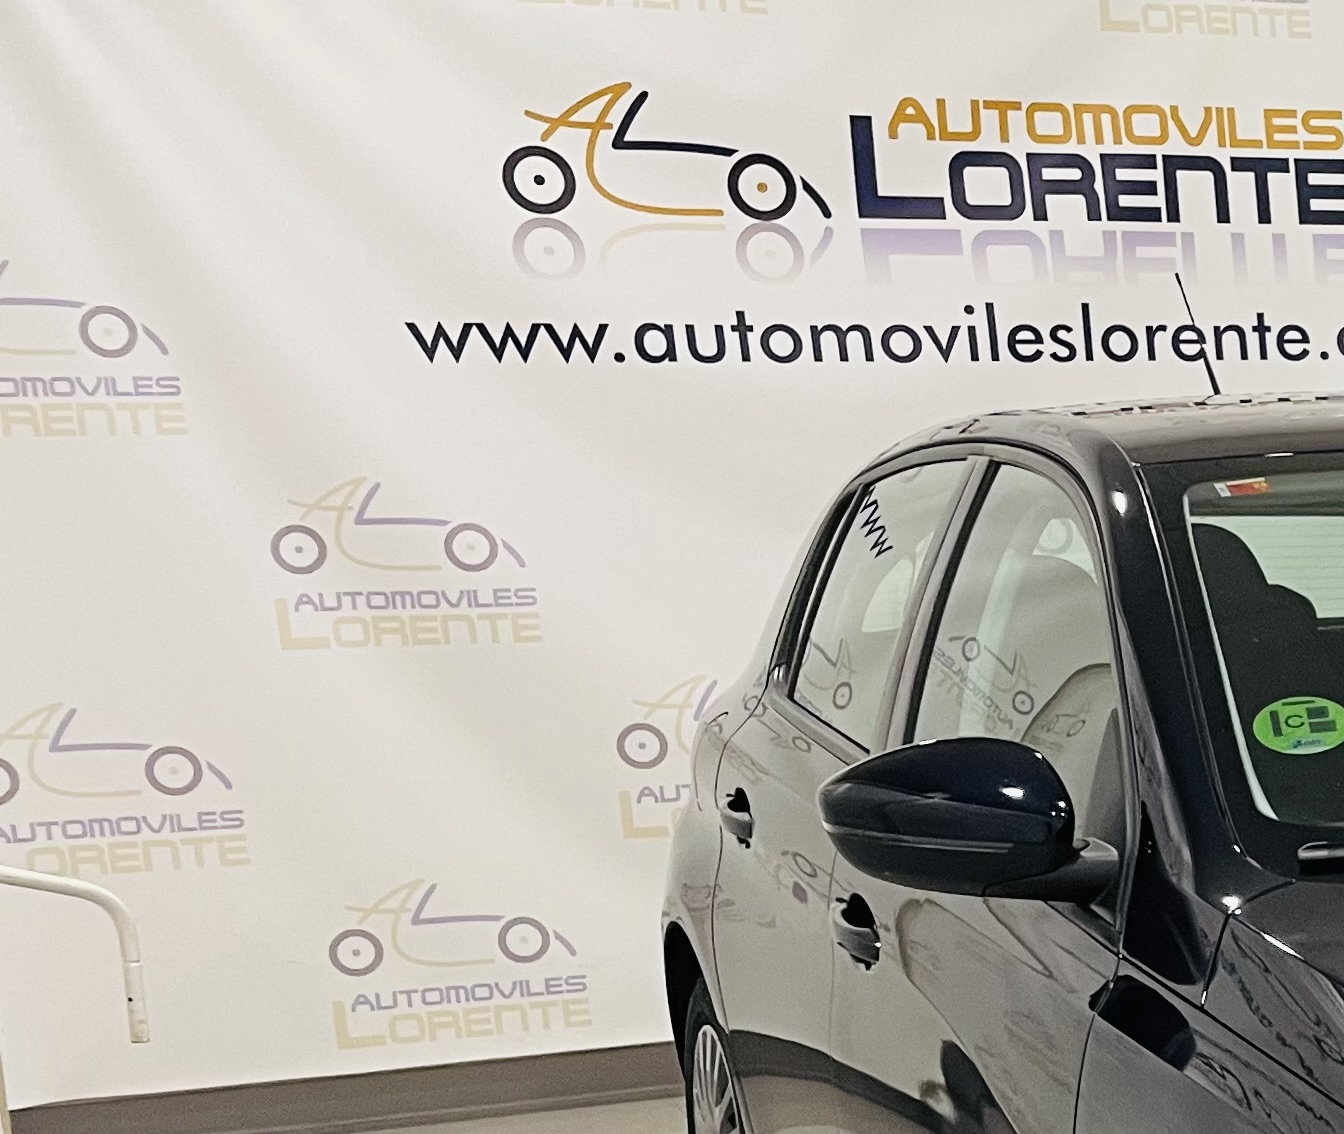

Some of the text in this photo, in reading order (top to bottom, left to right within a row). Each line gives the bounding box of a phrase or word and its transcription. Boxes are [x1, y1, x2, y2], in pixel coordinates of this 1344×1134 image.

[888, 97, 1344, 151] AUTOMOVILES
[274, 597, 543, 651] LORENTE
[294, 587, 538, 612] AUTOMOVILES
[351, 975, 588, 1012] AUTOMOVILES
[332, 997, 592, 1050] LORENTE
